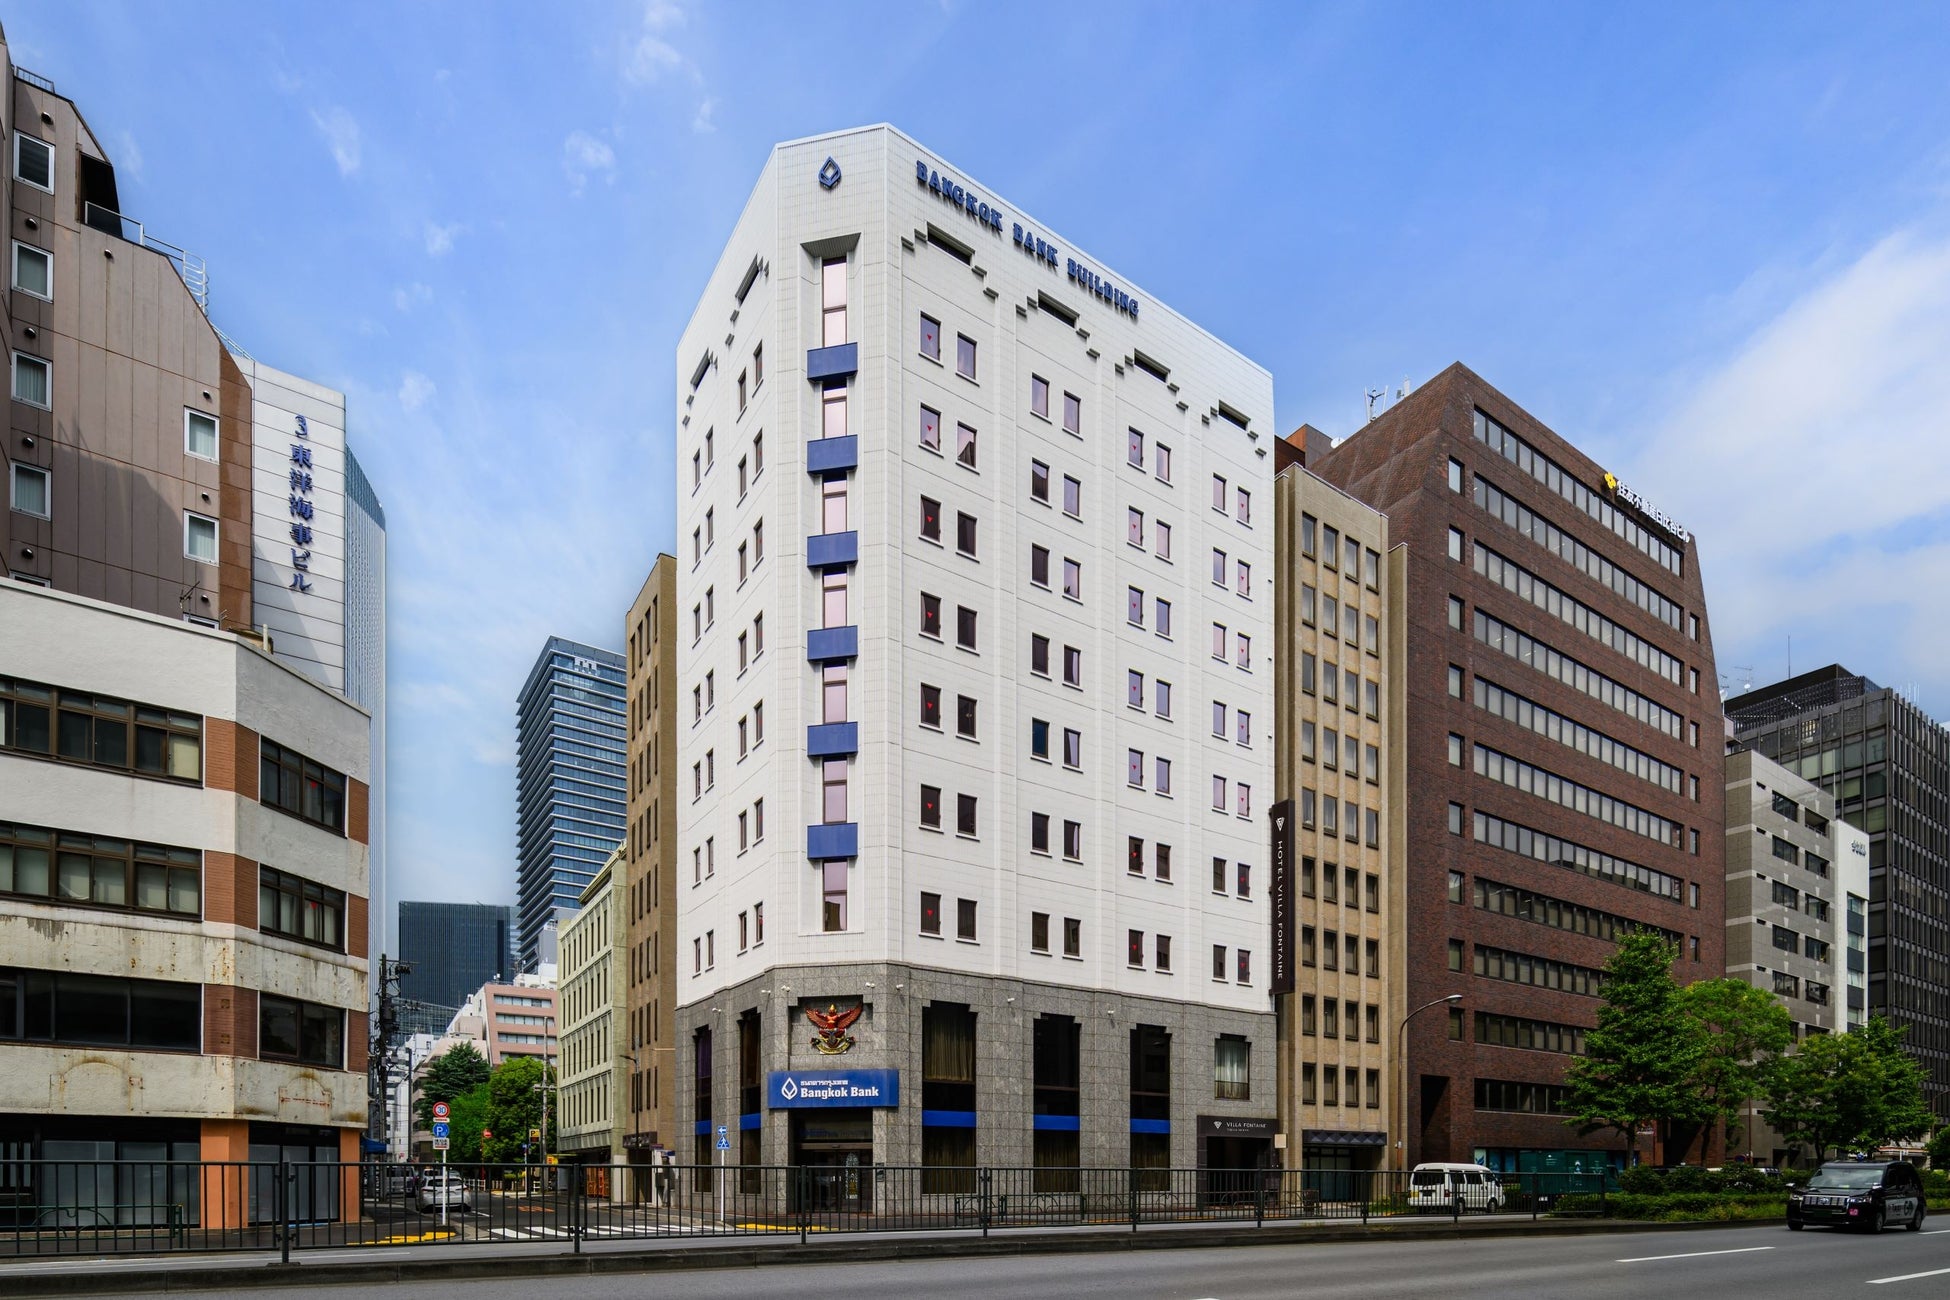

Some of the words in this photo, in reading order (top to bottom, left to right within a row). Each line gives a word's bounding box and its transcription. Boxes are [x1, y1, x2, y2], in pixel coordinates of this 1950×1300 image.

[916, 160, 1003, 232] BANGKOK
[1013, 222, 1059, 267] BANK
[1067, 257, 1140, 317] BUILDING
[800, 1086, 848, 1099] Bangkok
[850, 1086, 879, 1097] Bank
